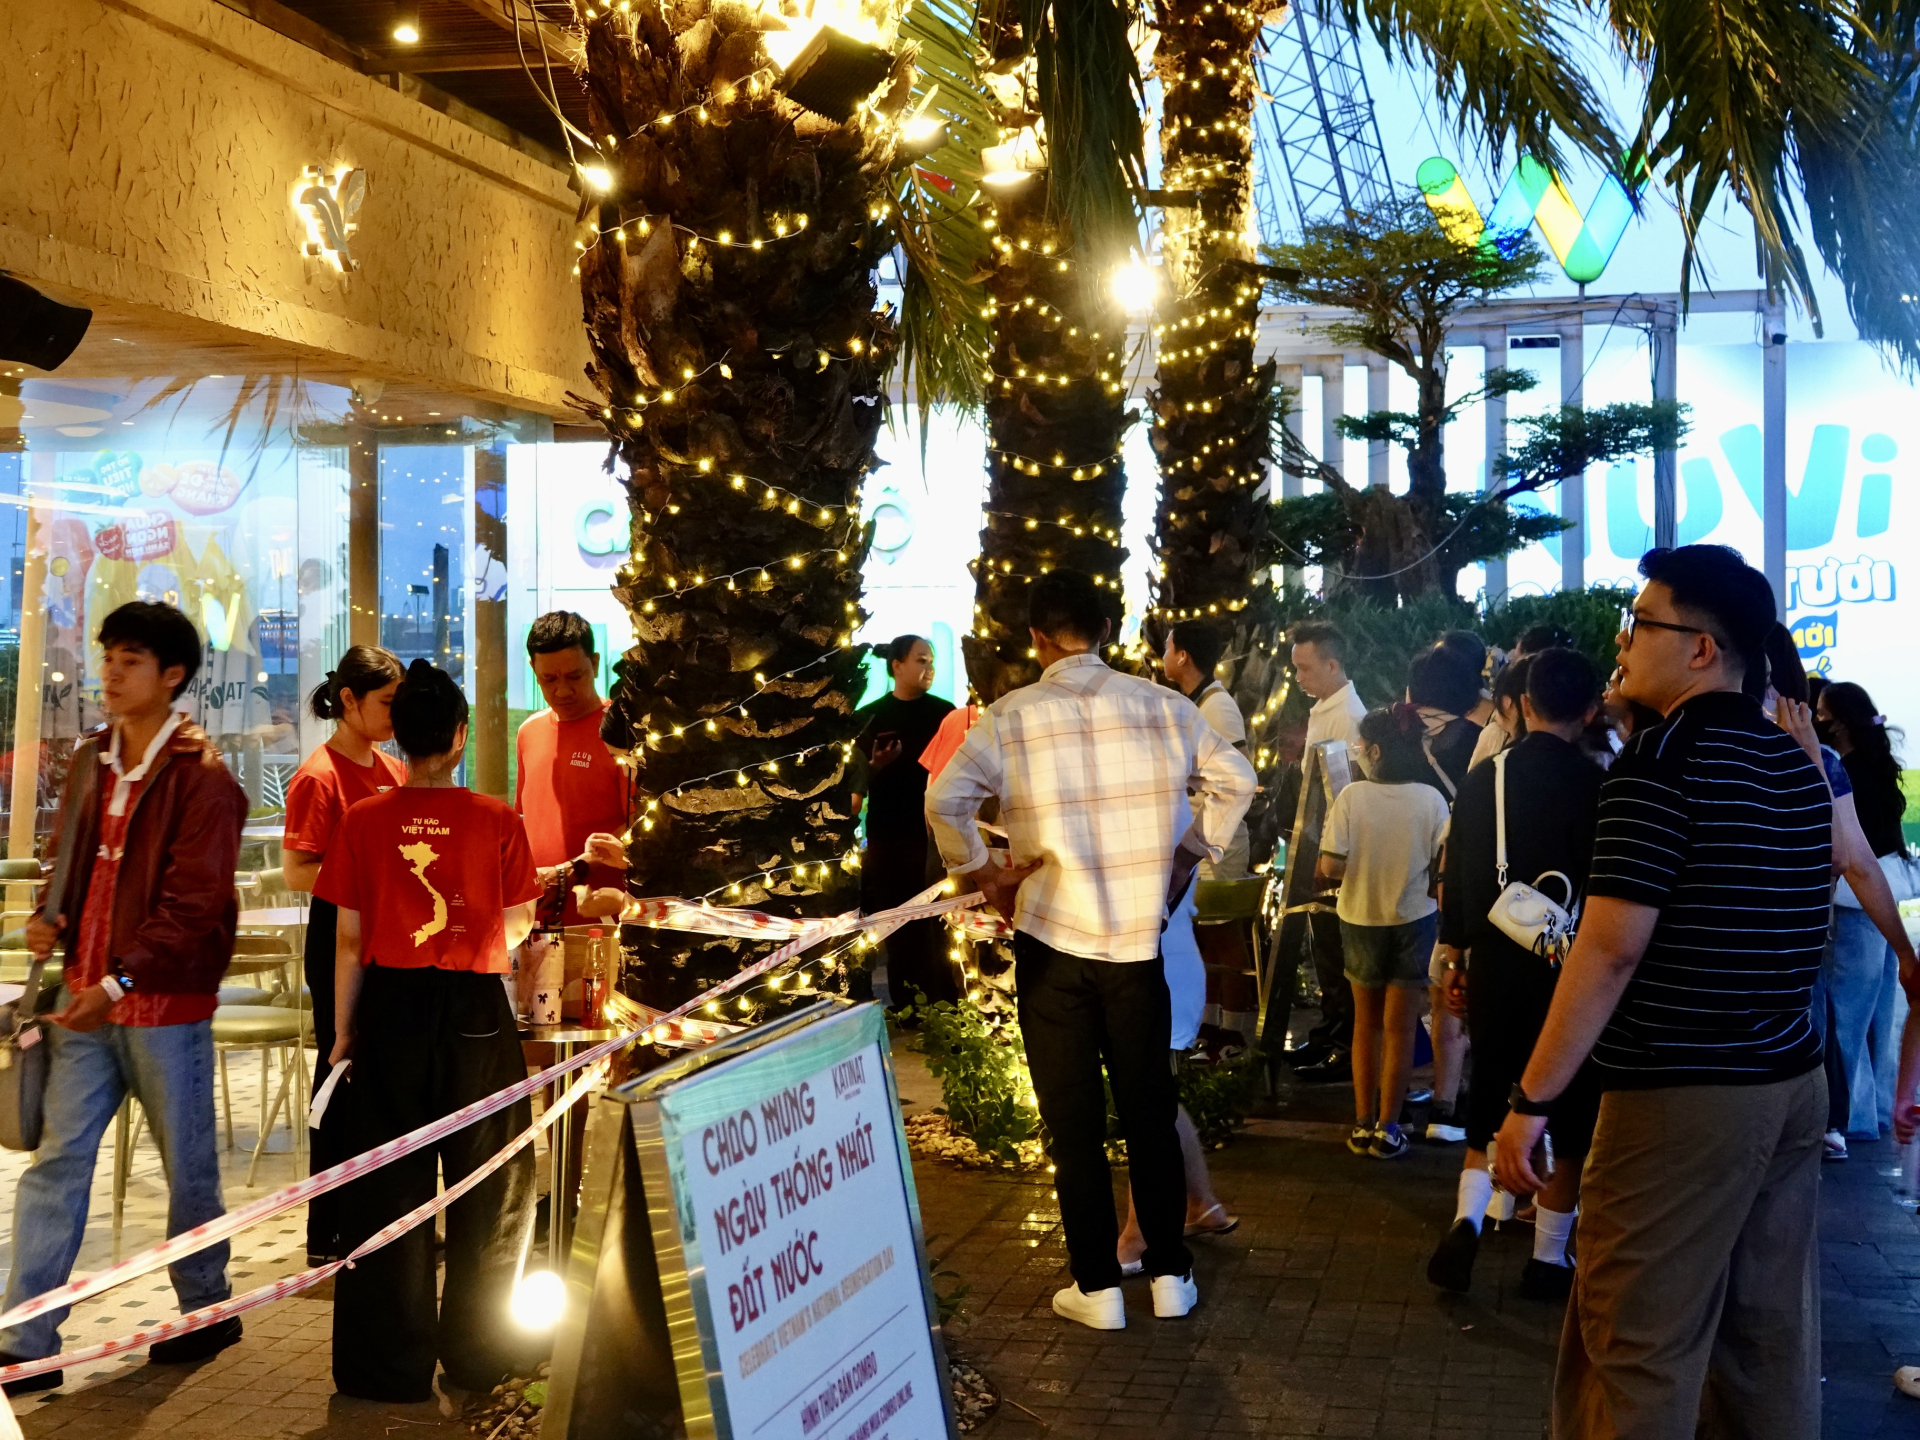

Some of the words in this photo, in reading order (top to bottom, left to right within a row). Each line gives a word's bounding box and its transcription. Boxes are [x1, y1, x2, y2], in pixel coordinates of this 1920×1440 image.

[427, 827, 450, 835] NAM
[831, 1055, 866, 1099] KATINAT
[714, 1179, 767, 1256] NGÀY
[770, 1145, 833, 1219] THỐNG
[836, 1112, 875, 1181] NHẤT
[728, 1255, 767, 1333] ĐẤT
[770, 1228, 823, 1303] NƯỚC
[852, 1351, 878, 1391] COMBO
